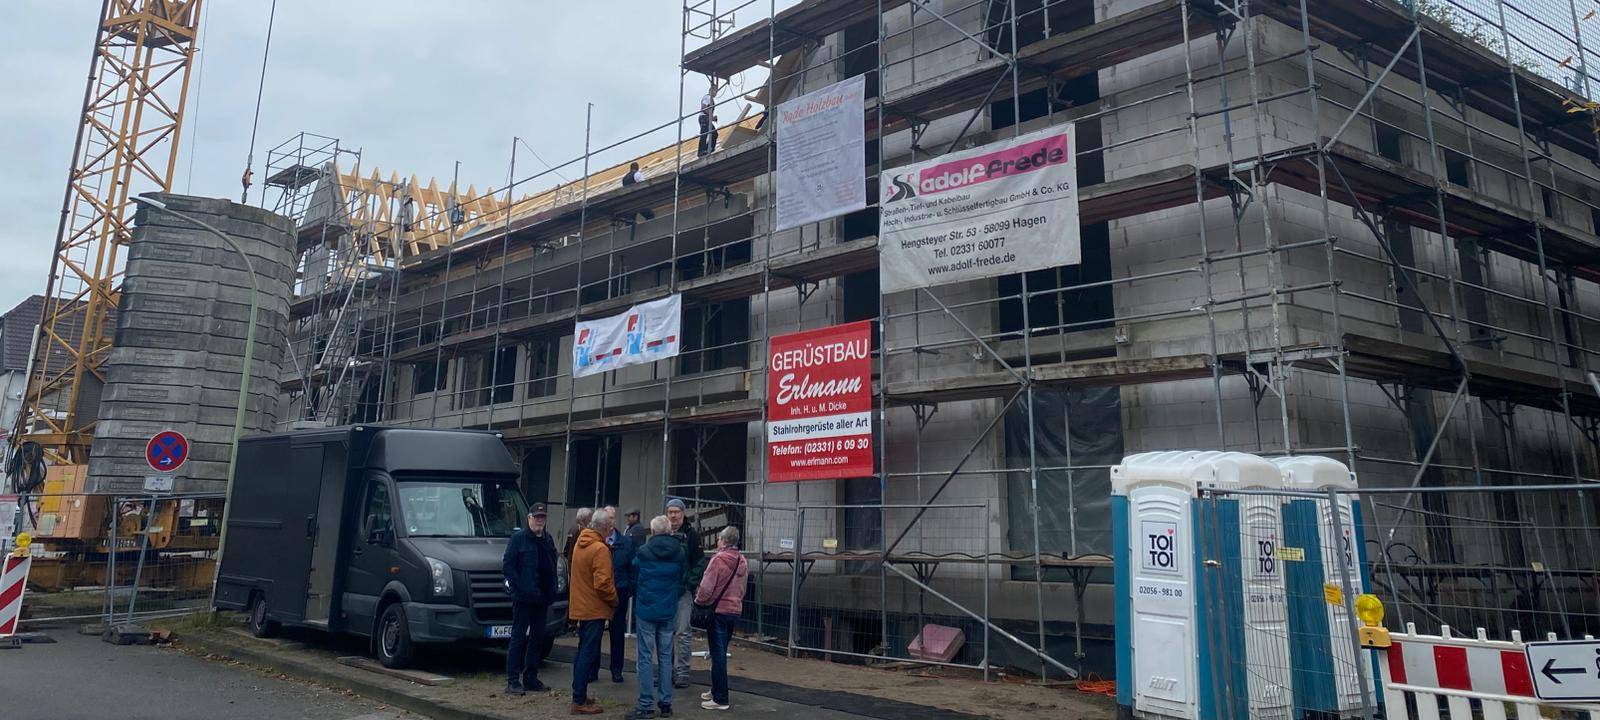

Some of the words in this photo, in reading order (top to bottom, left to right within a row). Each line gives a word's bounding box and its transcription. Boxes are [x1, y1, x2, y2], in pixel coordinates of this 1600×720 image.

[920, 163, 985, 194] adolf
[985, 146, 1064, 178] frede
[939, 194, 971, 205] Kabelbau
[1009, 189, 1031, 201] GmbH
[1032, 188, 1039, 196] &
[1040, 186, 1055, 194] Co.
[1056, 182, 1070, 191] KG
[900, 233, 948, 250] Hengsteyer
[949, 231, 964, 241] Str.
[966, 227, 977, 237] 53
[983, 221, 1010, 234] 58099
[1012, 215, 1047, 229] Hagen
[933, 249, 949, 259] Tel.
[950, 244, 975, 256] 02331
[978, 237, 1006, 251] 60077
[927, 253, 1016, 275] www.adolf-frede.de
[772, 338, 868, 372] GERÜSTBAU
[776, 373, 862, 405] Erlmann
[790, 406, 802, 415] Inh.
[803, 405, 811, 414] H.
[819, 403, 827, 412] M.
[828, 401, 847, 411] Dicke
[773, 420, 834, 435] Stahlrohrgerüste
[835, 419, 853, 429] aller
[855, 417, 868, 428] Art
[772, 443, 802, 456] Telefon:
[804, 440, 835, 455] (02331)
[836, 440, 842, 450] 6
[844, 439, 855, 450] 09
[857, 438, 869, 449] 30
[790, 456, 849, 467] www.erlmann.com
[1148, 533, 1173, 551] TOI
[1149, 550, 1174, 568] TOI
[1139, 586, 1158, 595] 02056
[1162, 587, 1173, 597] 981
[1174, 588, 1183, 597] 00
